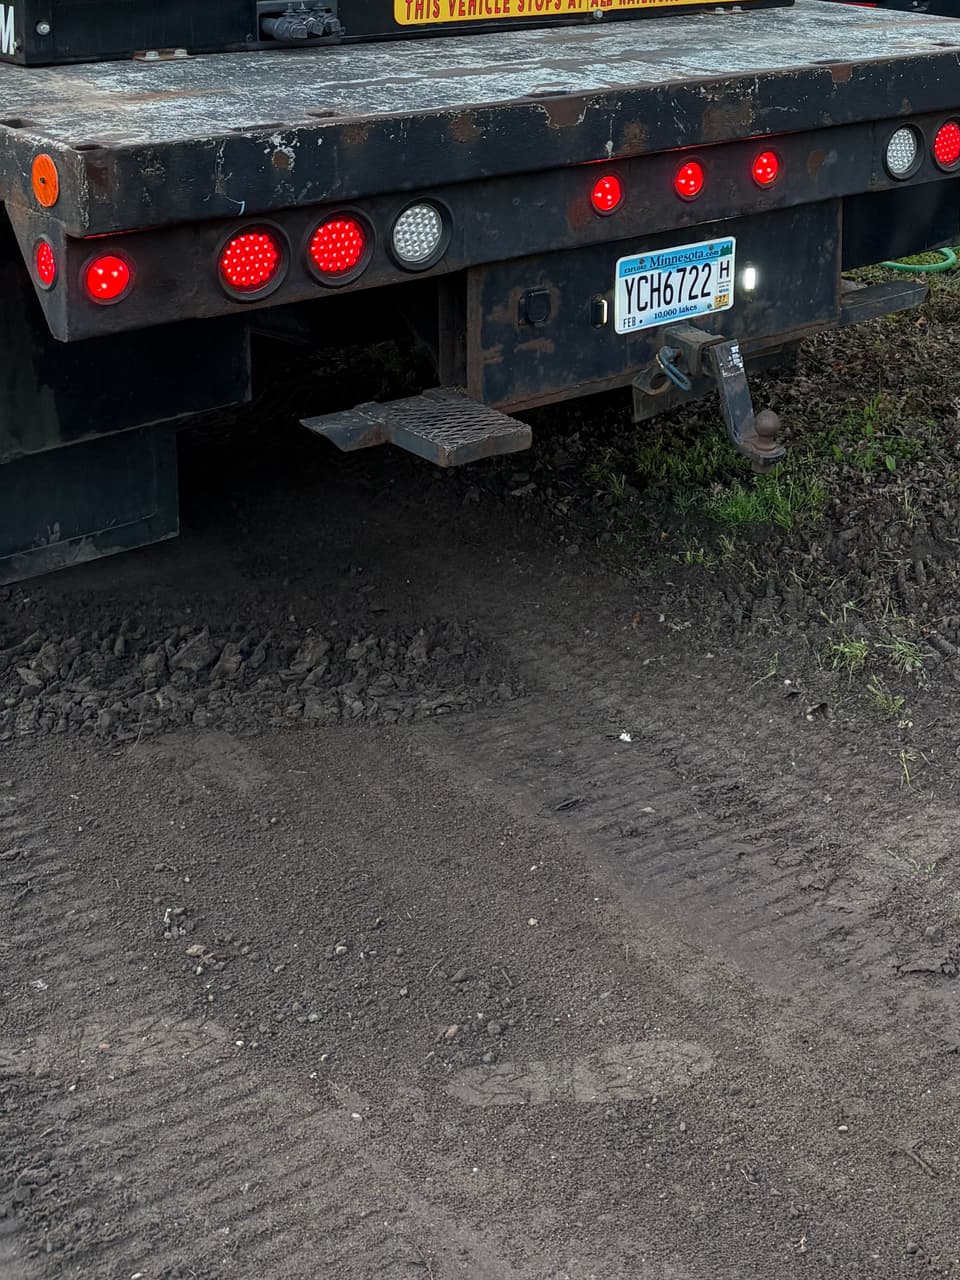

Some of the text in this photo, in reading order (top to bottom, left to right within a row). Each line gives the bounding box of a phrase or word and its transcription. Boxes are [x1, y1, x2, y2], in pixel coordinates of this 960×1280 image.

[649, 249, 719, 268] Minnesota.com
[720, 260, 730, 279] H
[625, 262, 712, 314] YCH6722
[654, 304, 698, 319] 10,000 lakes
[623, 316, 636, 328] FEB
